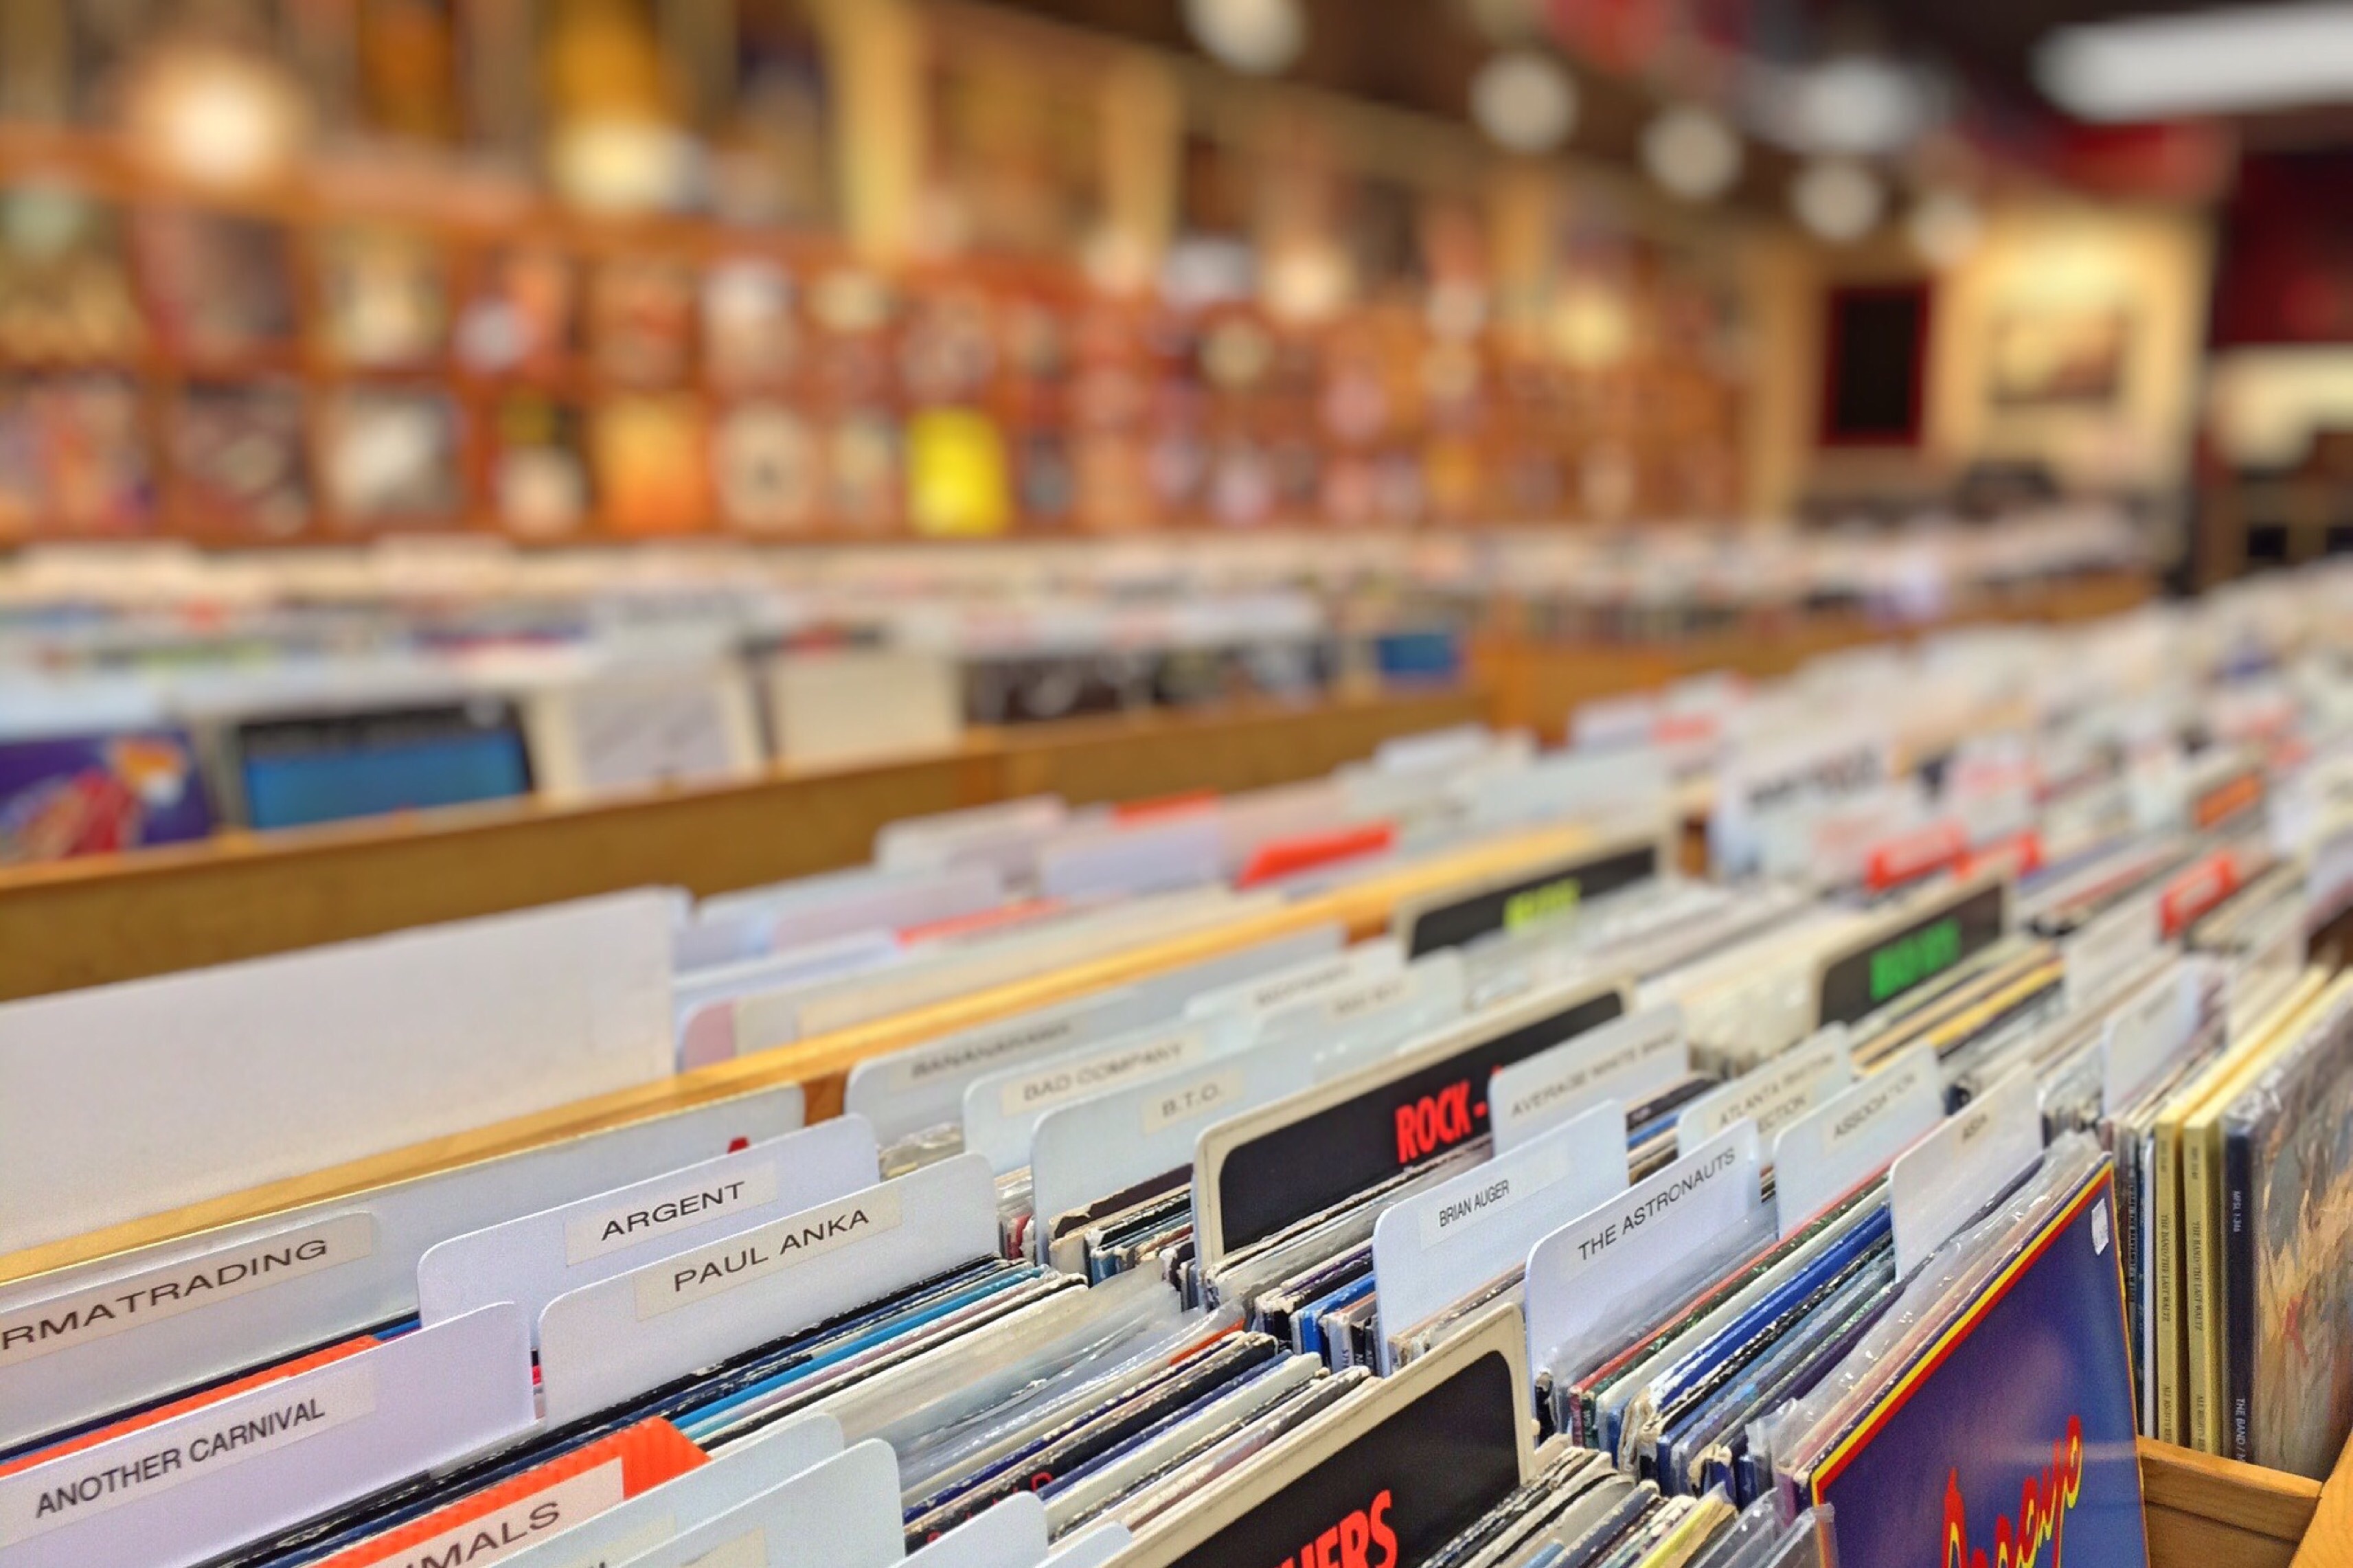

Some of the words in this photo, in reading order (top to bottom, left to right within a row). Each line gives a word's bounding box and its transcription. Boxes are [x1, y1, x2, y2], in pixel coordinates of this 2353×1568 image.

[1023, 1074, 1071, 1102] BAD
[1758, 1093, 1806, 1134] ECTION
[1395, 1078, 1472, 1163] ROCK
[601, 1181, 745, 1241] ARGENT
[1438, 1197, 1471, 1227] BRIAN
[1474, 1179, 1510, 1211] AUGER
[1578, 1225, 1618, 1261] THE
[1622, 1147, 1736, 1236] ASTRONAUTS
[674, 1247, 769, 1293] PAUL
[780, 1209, 869, 1255] ANKA
[2, 1240, 327, 1350] RMATRADING
[2236, 1398, 2246, 1416] THE
[2236, 1418, 2246, 1445] BAND
[36, 1448, 181, 1519] ANOTHER
[189, 1398, 326, 1462] CARNIVAL
[406, 1500, 560, 1568] MALS
